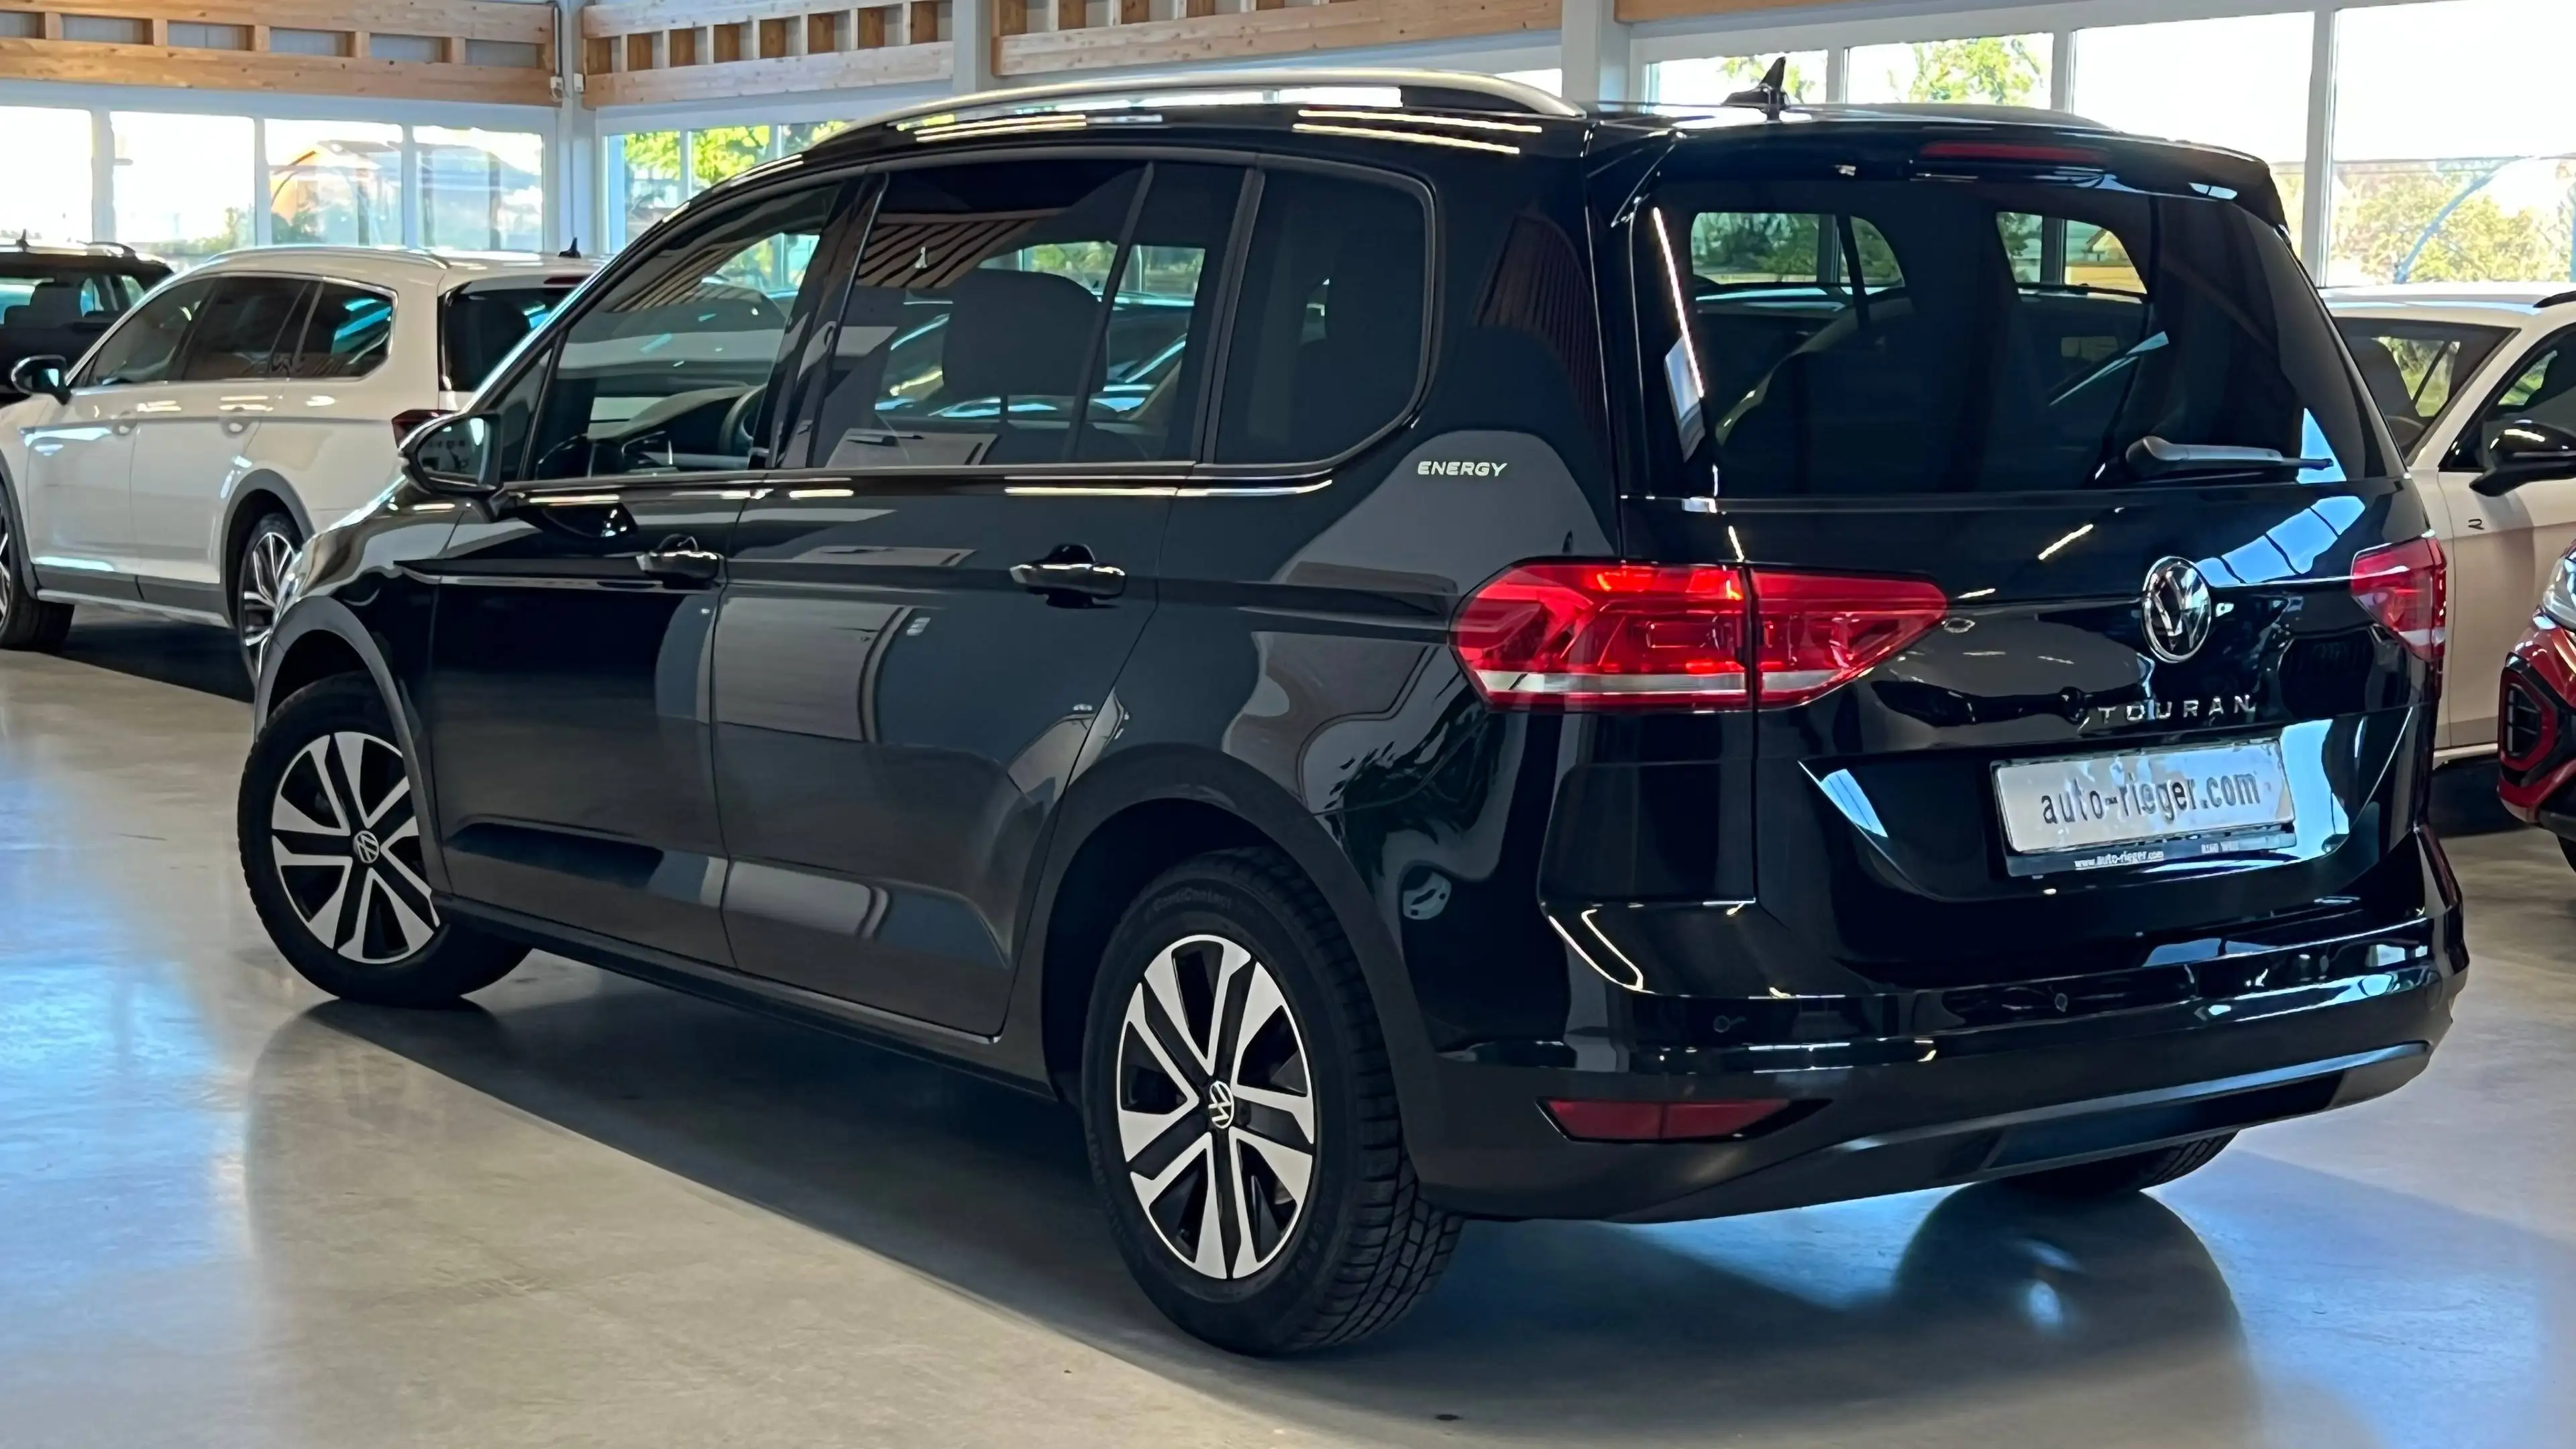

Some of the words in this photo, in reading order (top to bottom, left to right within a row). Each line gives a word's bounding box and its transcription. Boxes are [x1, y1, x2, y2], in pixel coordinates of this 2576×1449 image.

[1417, 461, 1508, 477] ENERGY
[2097, 694, 2257, 723] TOURAN
[2041, 772, 2261, 824] auto-rieger.com
